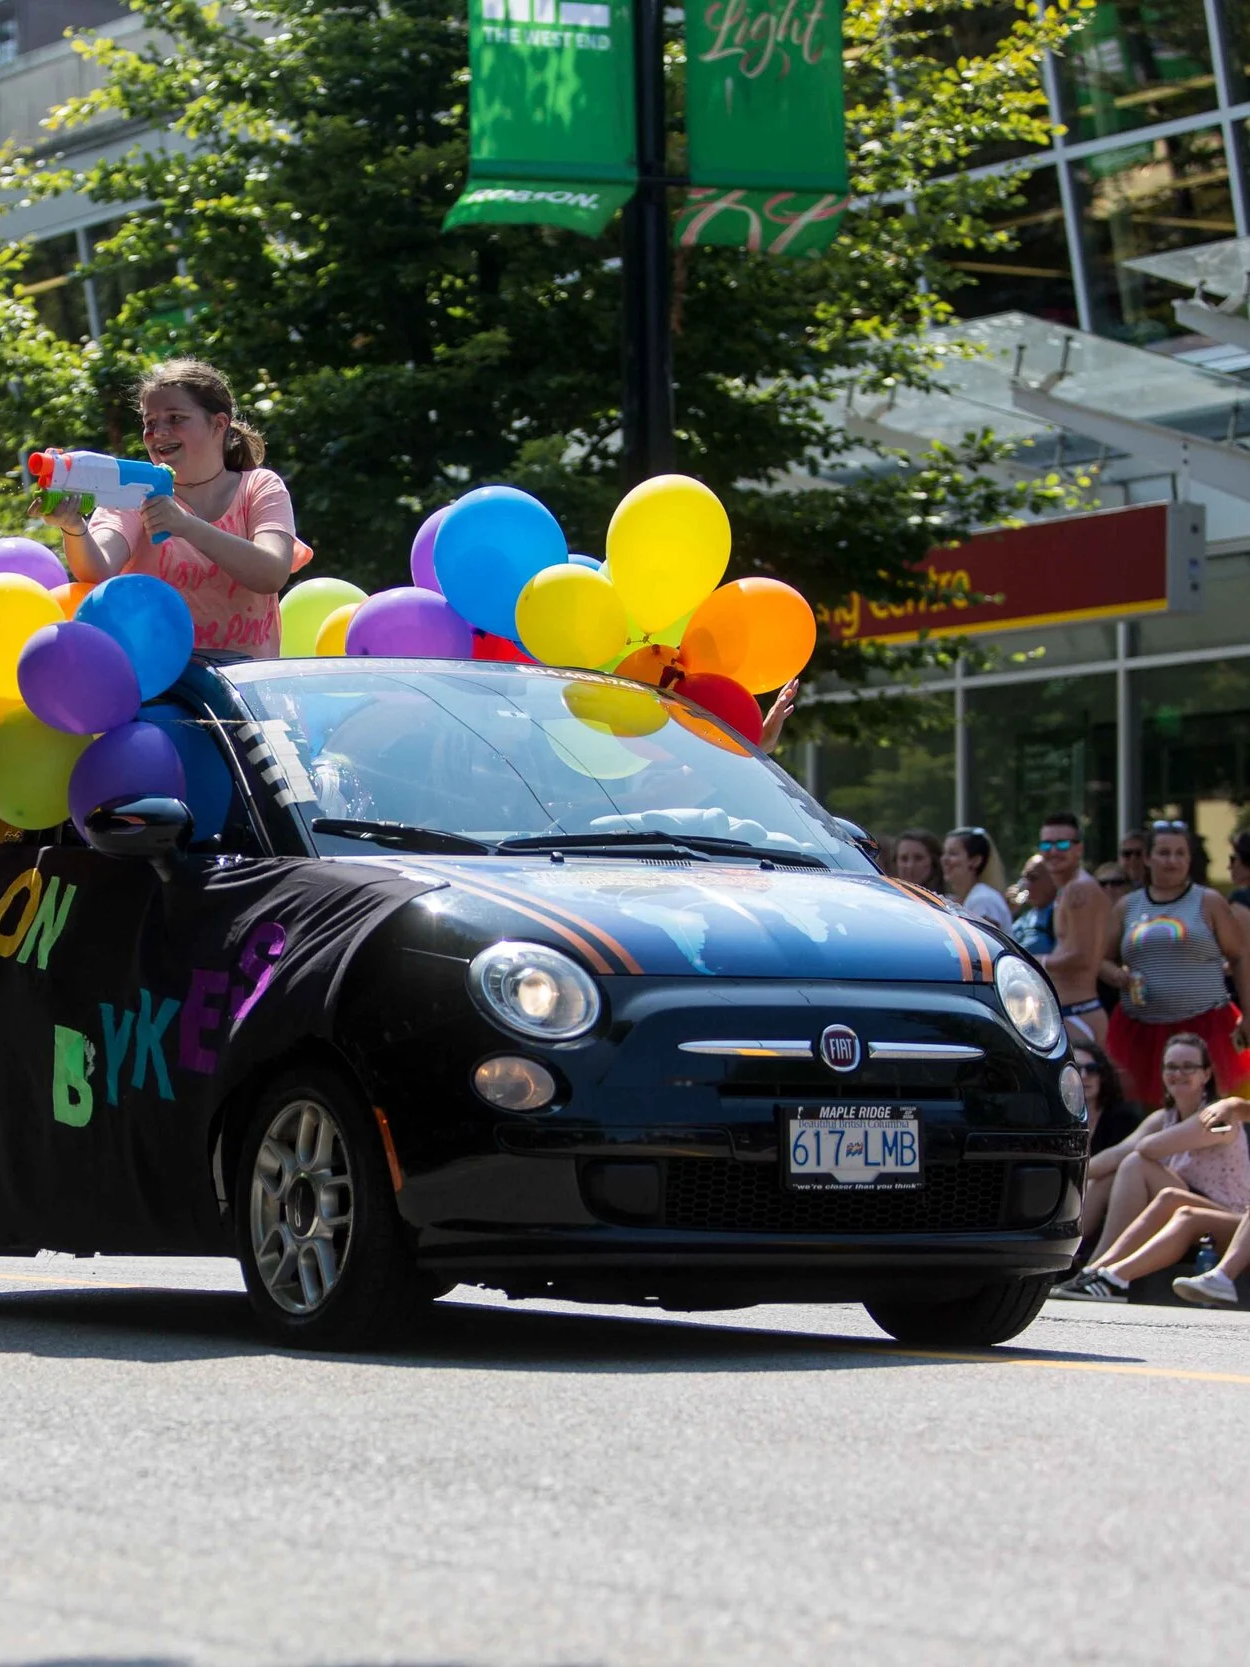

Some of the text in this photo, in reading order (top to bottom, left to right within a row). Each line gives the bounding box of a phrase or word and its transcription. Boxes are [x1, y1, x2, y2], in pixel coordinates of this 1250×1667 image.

[484, 26, 611, 50] THE WEST END
[699, 0, 827, 79] Light
[52, 922, 286, 1127] BYKES
[829, 1038, 852, 1060] FIAT
[798, 1119, 909, 1129] Beautiful British Columbia
[819, 1106, 856, 1119] MAPLE
[858, 1106, 892, 1119] RIDGE
[793, 1130, 917, 1166] 617 LMB
[855, 1183, 876, 1191] than
[877, 1184, 894, 1192] you
